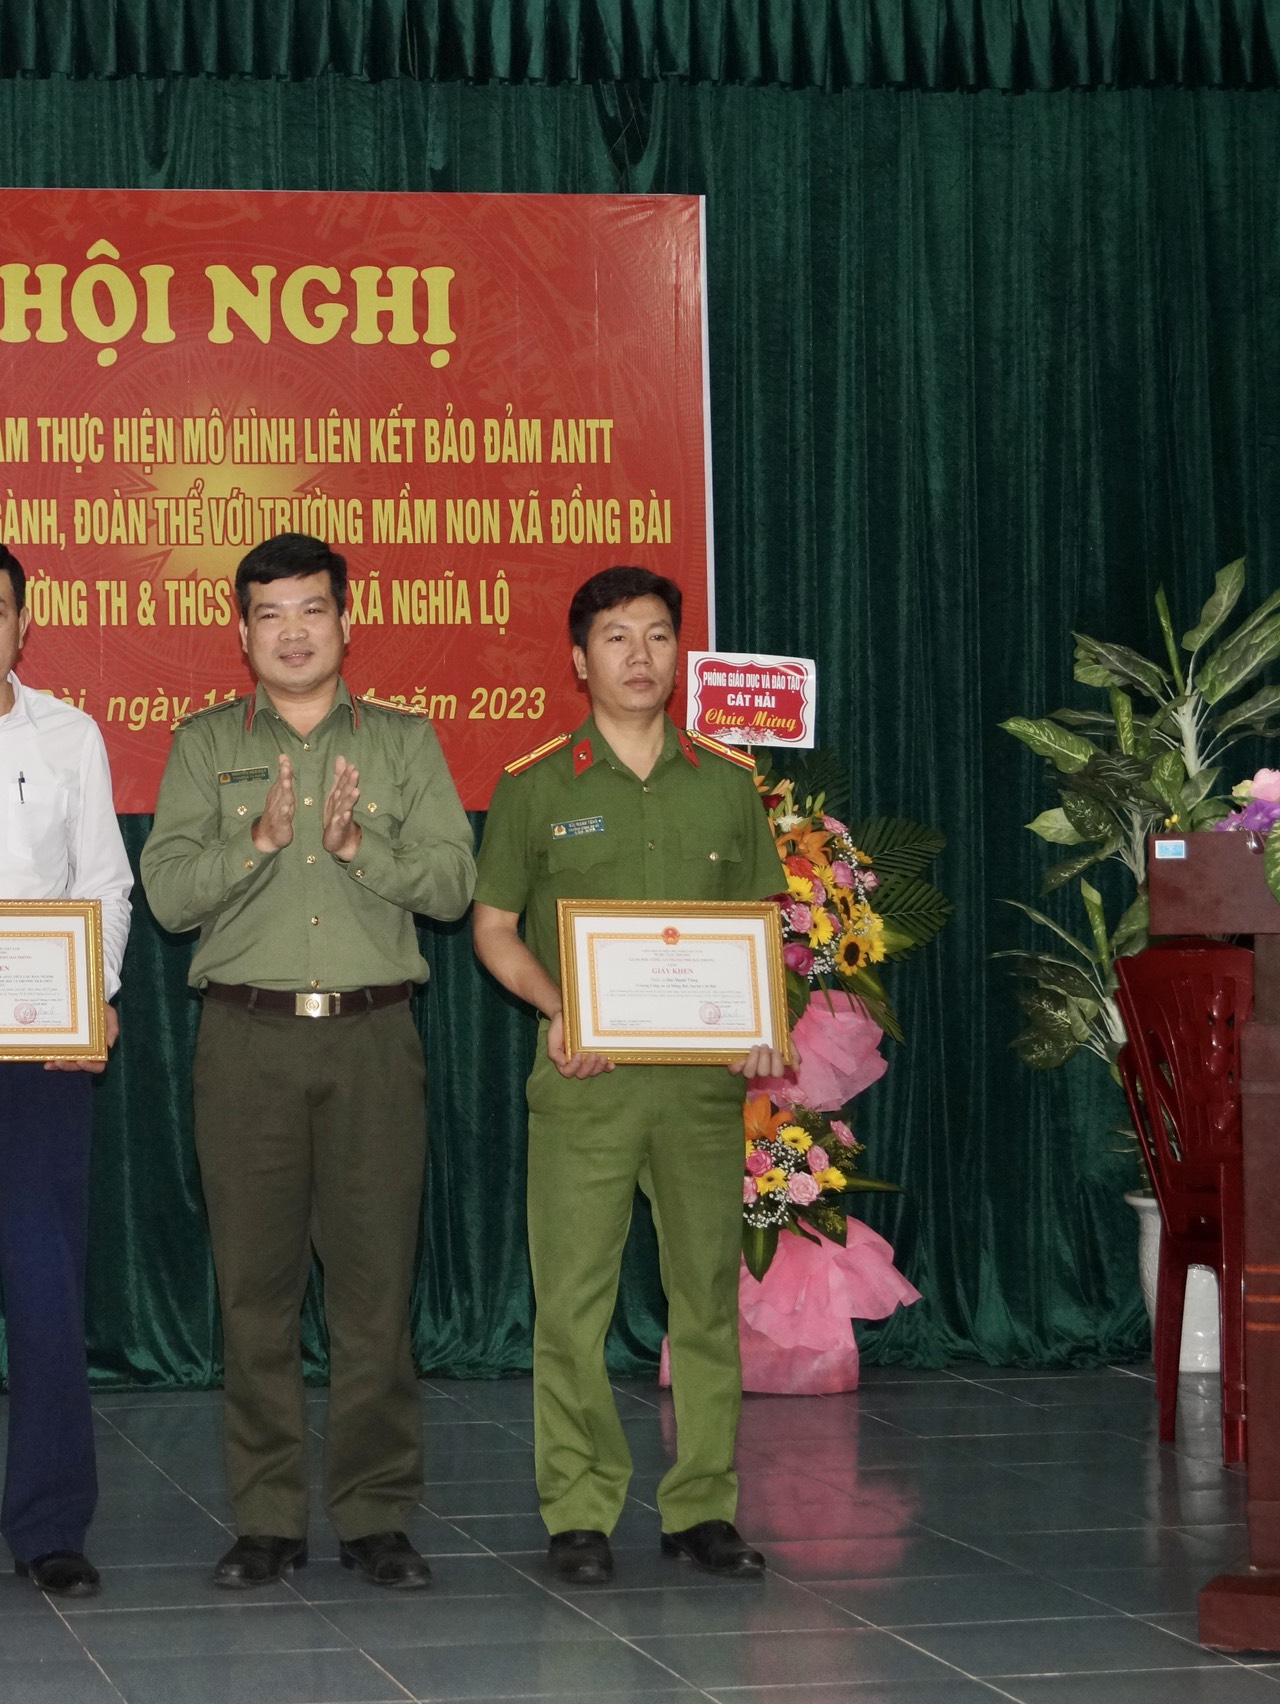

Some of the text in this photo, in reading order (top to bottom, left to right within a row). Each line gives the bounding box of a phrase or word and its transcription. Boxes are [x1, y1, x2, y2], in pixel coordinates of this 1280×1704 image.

[204, 264, 457, 369] NGHỊ
[37, 412, 105, 474] THỰC
[113, 408, 175, 474] HIỆN
[183, 408, 225, 464] MÔ
[233, 408, 296, 463] HÌNH
[304, 408, 362, 463] LIÊN
[370, 403, 416, 463] KẾT
[424, 402, 476, 464] BẢO
[483, 402, 542, 463] ĐẢM
[550, 418, 614, 464] ANTT
[73, 488, 147, 545] ĐOÀN
[154, 479, 203, 545] THỂ
[210, 488, 253, 545] VỚI
[261, 487, 364, 545] TRƯỜNG
[372, 482, 437, 544] MẦM
[445, 498, 501, 545] NON
[508, 489, 544, 544] XÃ
[550, 483, 621, 544] ĐỒNG
[629, 489, 671, 544] BÀI
[95, 580, 128, 627] TH
[137, 580, 156, 627] &
[164, 580, 232, 627] THCS
[349, 569, 510, 635] XÃ NGHĨA LỘ
[702, 668, 727, 687] PHÒNG
[728, 670, 745, 688] GIÁO
[745, 673, 760, 691] DỤC
[761, 671, 771, 689] VÀ
[727, 692, 776, 708] CÁT HẢI
[106, 687, 192, 731] ngày
[468, 687, 546, 720] 2023
[705, 708, 797, 732] Chúc Mừng
